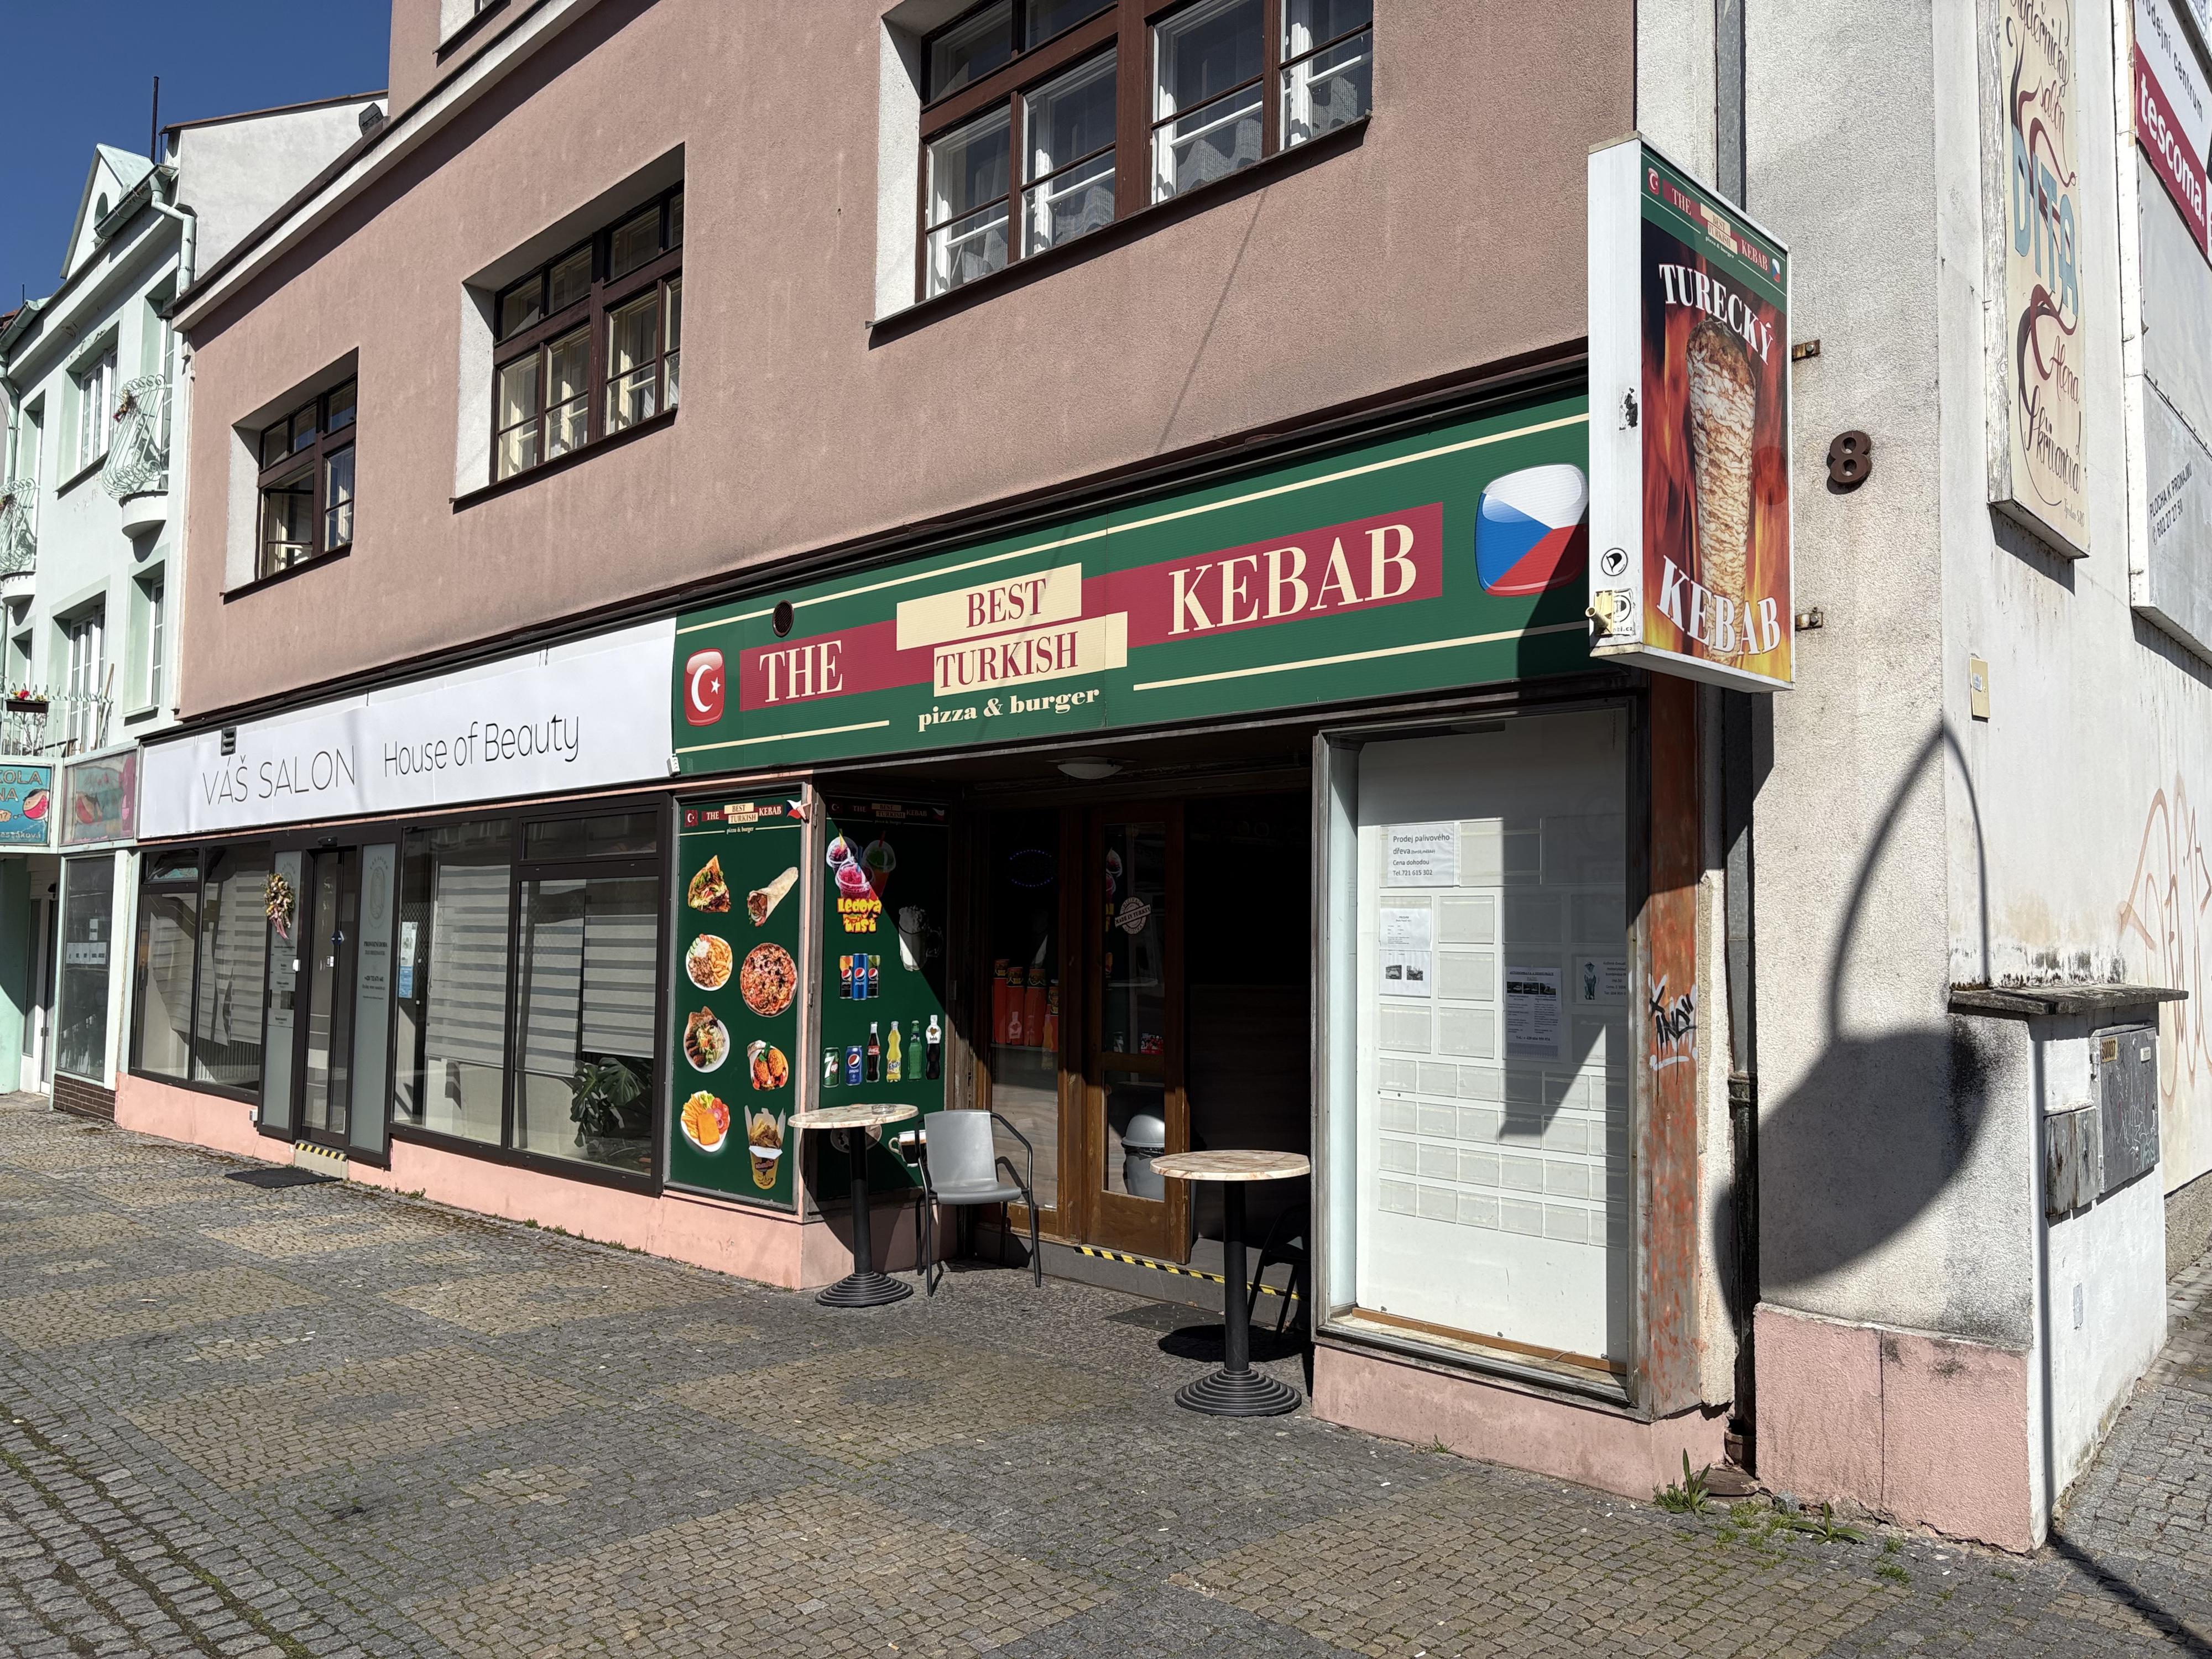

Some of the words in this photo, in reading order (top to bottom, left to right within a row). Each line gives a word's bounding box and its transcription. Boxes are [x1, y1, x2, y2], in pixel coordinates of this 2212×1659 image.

[2137, 0, 2172, 59] odejní
[2174, 51, 2203, 123] centrum
[1672, 187, 1692, 216] THE
[1713, 214, 1726, 231] BEST
[1741, 239, 1768, 271] KEBAB
[1705, 236, 1716, 247] pizza
[1708, 222, 1731, 248] TURKISH
[1658, 262, 1775, 367] TURECKÝ
[1828, 430, 1872, 487] 8
[2150, 488, 2168, 520] PLOCHA
[2167, 483, 2172, 501] K
[2157, 517, 2166, 538] 602
[2165, 510, 2172, 529] 27
[2171, 503, 2178, 523] 27
[2177, 498, 2183, 515] 50
[759, 640, 843, 703] THE
[966, 578, 1046, 628] BEST
[1167, 524, 1417, 635] KEBAB
[1656, 555, 1781, 657] KEBAB
[936, 631, 1078, 688] TURKISH
[917, 706, 978, 732] pizza
[983, 698, 1003, 717] &
[1009, 689, 1100, 714] burger
[202, 754, 248, 806] VÁŠ
[258, 745, 356, 799] SALON
[385, 740, 447, 778] House
[454, 721, 478, 767] of
[484, 714, 580, 763] Beauty
[707, 811, 719, 821] THE
[732, 805, 746, 813] BEST
[759, 806, 782, 817] KEBAB
[729, 813, 757, 823] TURKISH
[1393, 835, 1413, 843] Prodej
[1415, 833, 1450, 843] palivového
